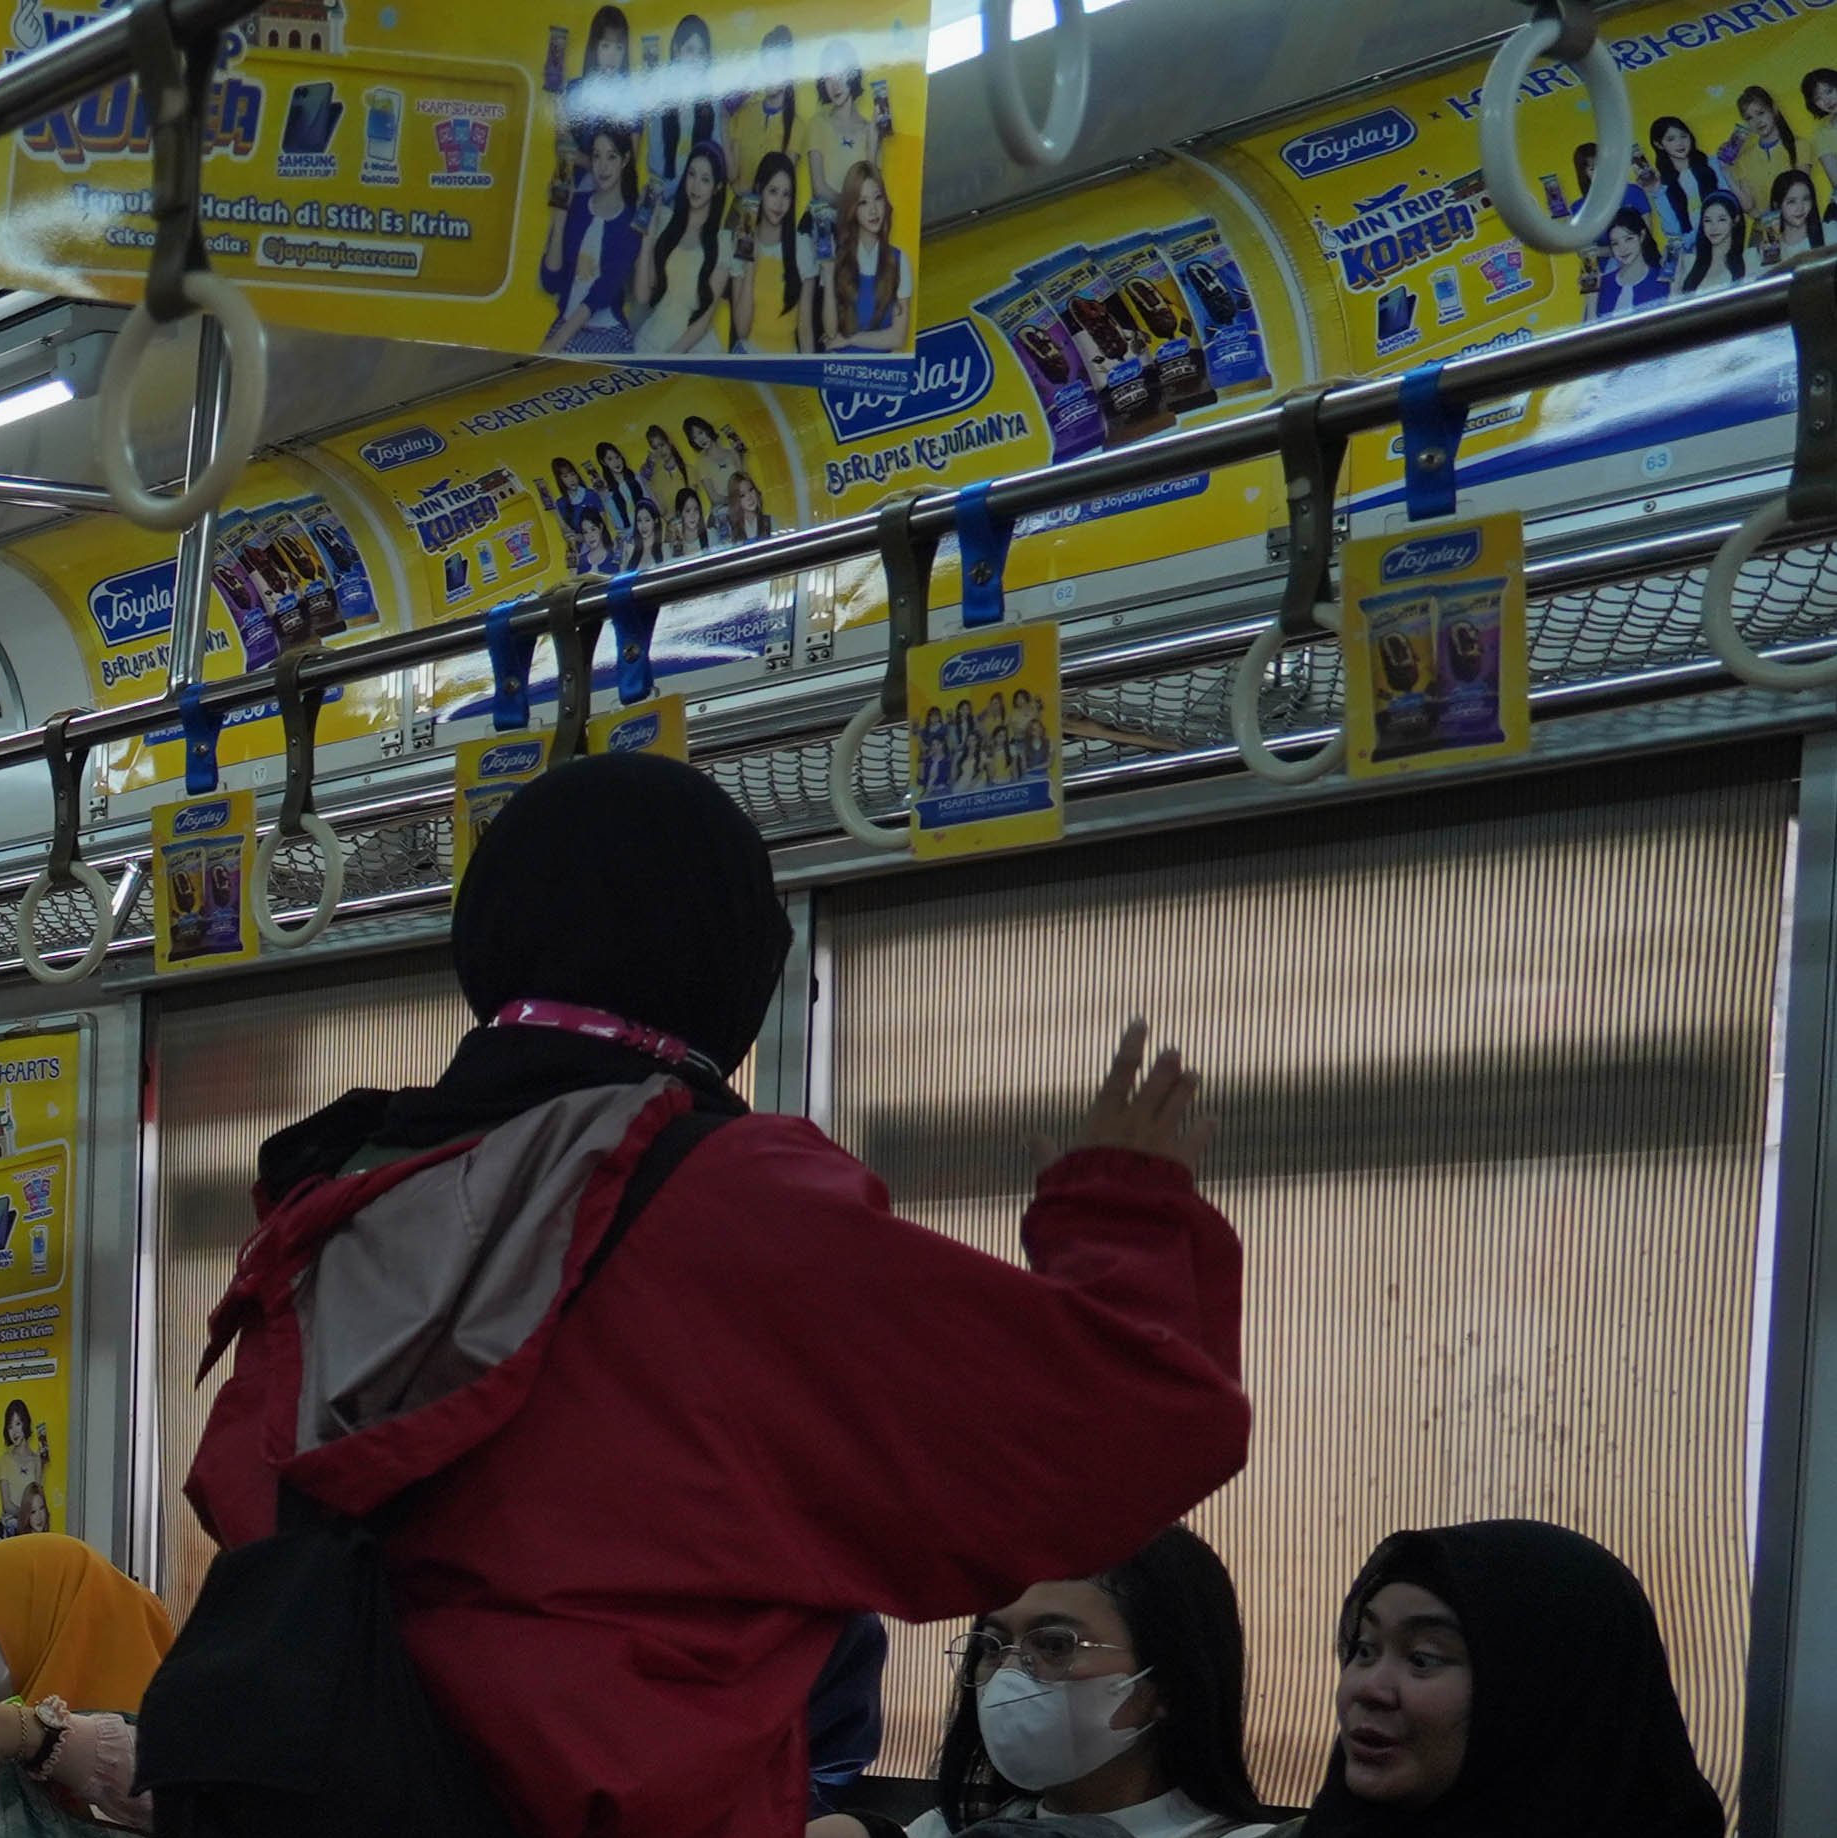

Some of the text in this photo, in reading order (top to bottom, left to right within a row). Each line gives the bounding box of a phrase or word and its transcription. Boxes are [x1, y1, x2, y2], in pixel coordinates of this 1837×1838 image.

[1295, 122, 1399, 168] Joyday
[278, 155, 336, 168] SAMSUNG
[431, 174, 492, 186] PHOTOCARD
[71, 183, 472, 239] Temuk Hadiah di Stik Es Krim
[1334, 188, 1447, 246] WIN TRIP
[105, 228, 133, 247] Cek
[262, 236, 418, 270] @joydayicecream
[1341, 204, 1475, 289] KOREA
[370, 436, 437, 466] Joyday
[1646, 453, 1668, 471] 63
[410, 484, 480, 521] WIN TRIP
[1090, 476, 1200, 513] @JoydayIceCream
[418, 497, 499, 552] KOREA
[1386, 542, 1471, 574] Joyday
[101, 583, 176, 630] Joyda
[1056, 587, 1073, 600] 62
[944, 655, 1015, 683] Joyday
[611, 722, 656, 750] Joyday
[483, 750, 536, 773] Joyday
[176, 808, 226, 832] Joyday
